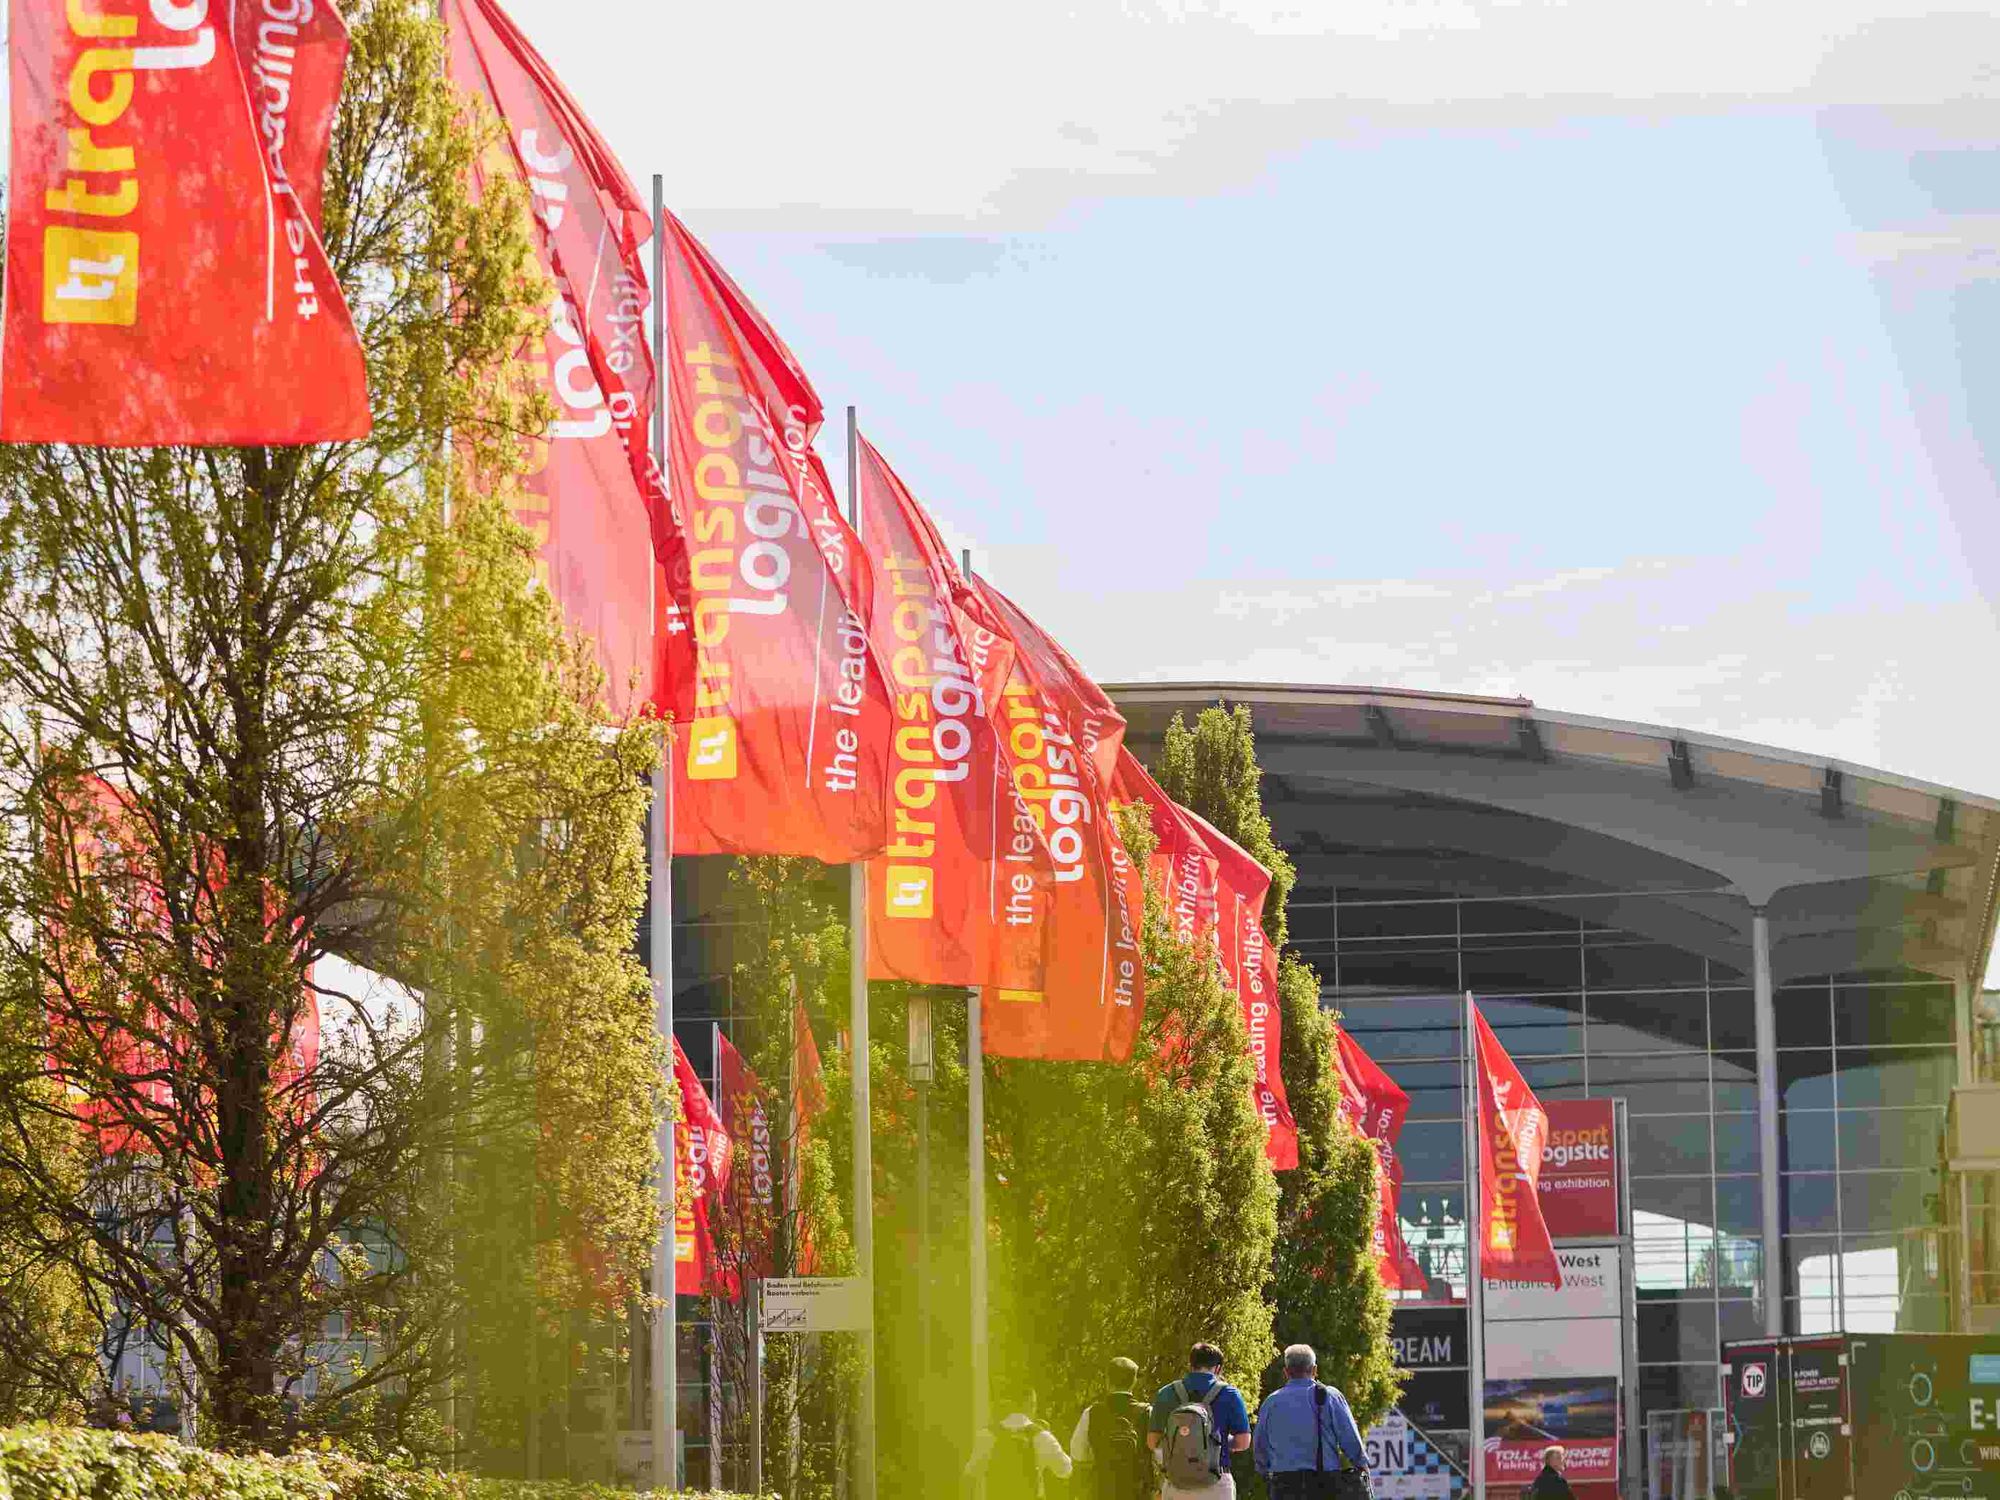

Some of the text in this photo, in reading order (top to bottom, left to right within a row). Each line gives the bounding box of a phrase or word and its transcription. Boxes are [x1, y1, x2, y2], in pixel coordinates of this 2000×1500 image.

[684, 341, 746, 708] transport
[886, 551, 942, 859] transport
[825, 728, 858, 793] the
[1005, 873, 1033, 927] the
[1114, 959, 1134, 1008] the
[1551, 1126, 1609, 1149] sport
[1554, 1177, 1611, 1191] exhibition
[1559, 1254, 1601, 1268] West
[1565, 1273, 1606, 1287] West
[1746, 1374, 1763, 1388] TIP
